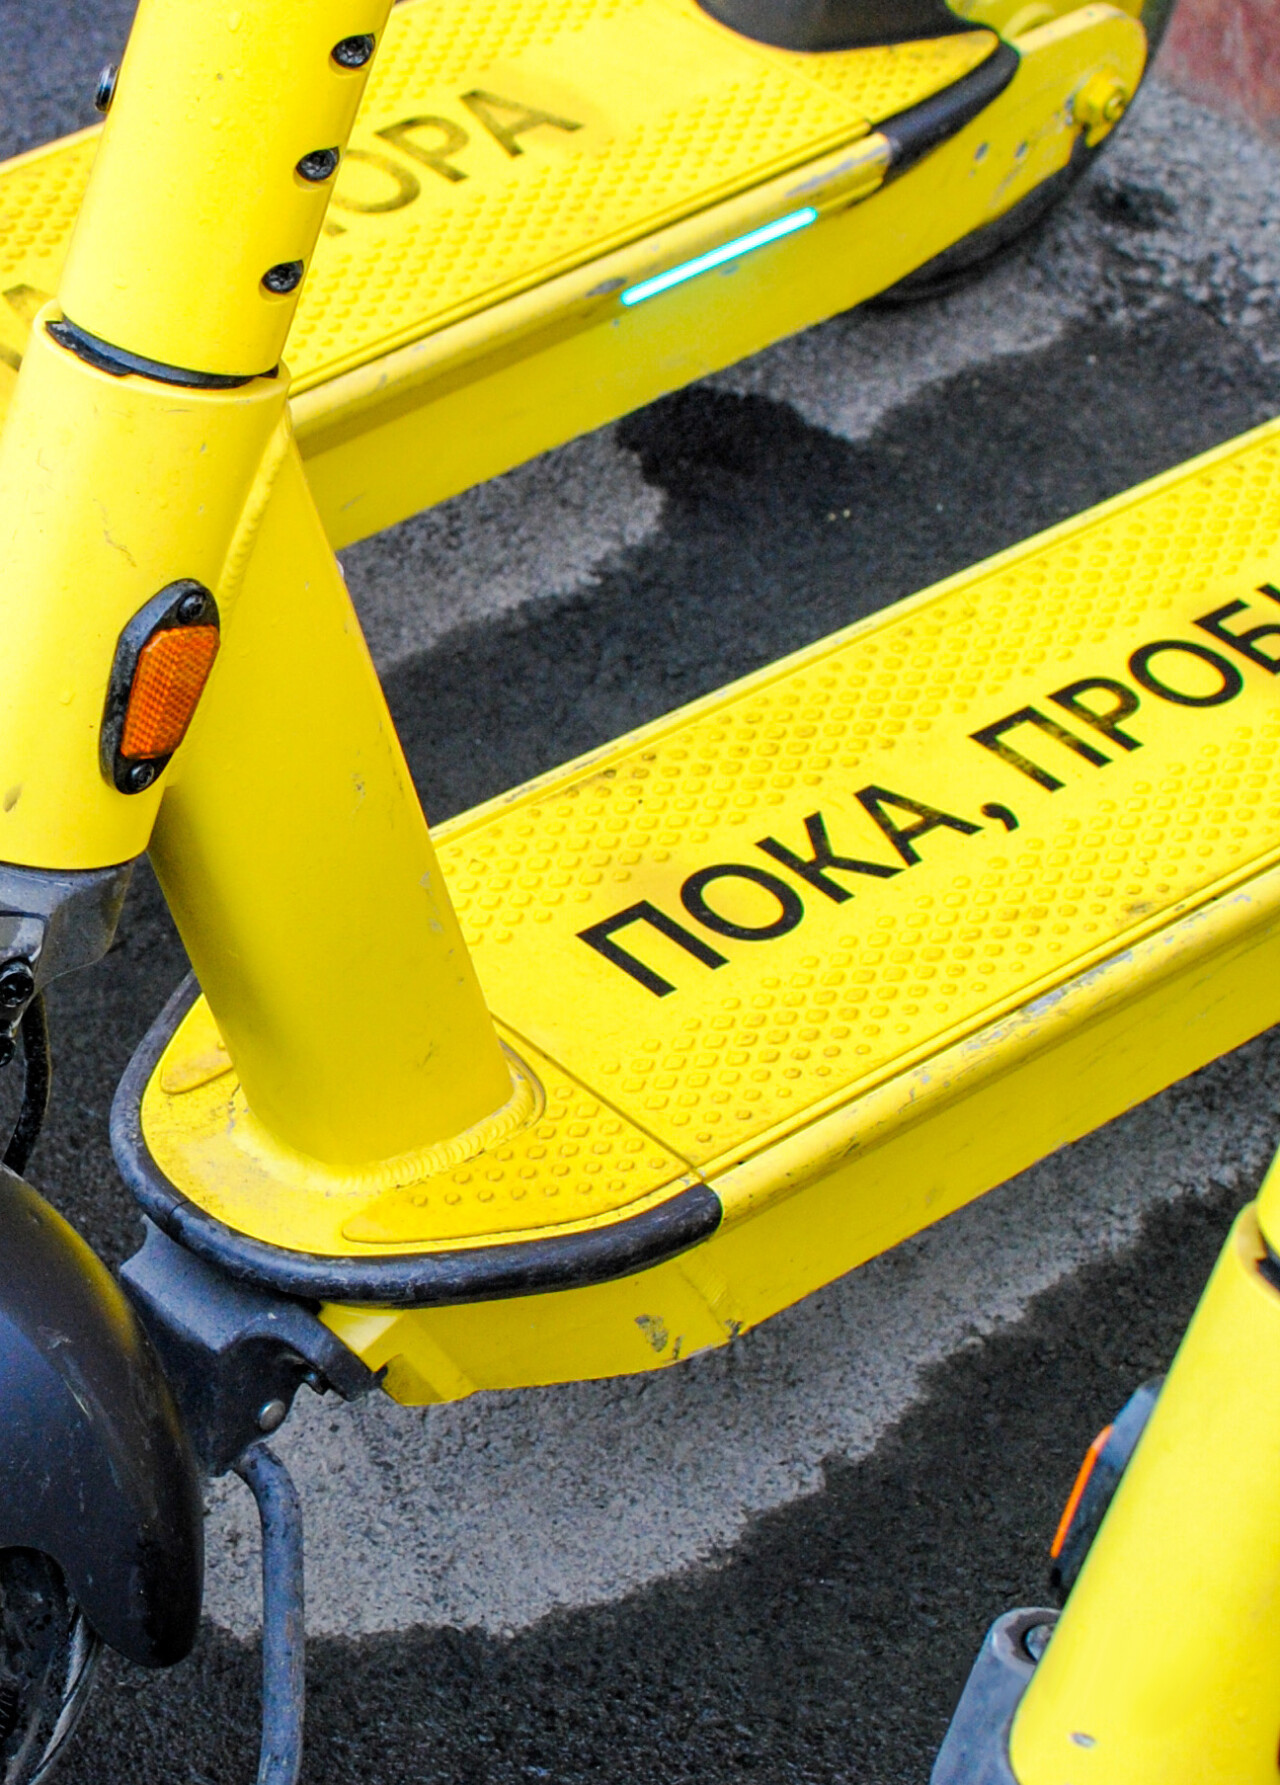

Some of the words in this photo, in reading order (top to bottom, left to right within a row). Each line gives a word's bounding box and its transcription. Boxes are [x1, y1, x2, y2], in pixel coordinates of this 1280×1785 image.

[322, 88, 583, 237] ОРА
[576, 784, 1020, 998] ПОКА,
[968, 583, 1280, 792] ПРОБ
